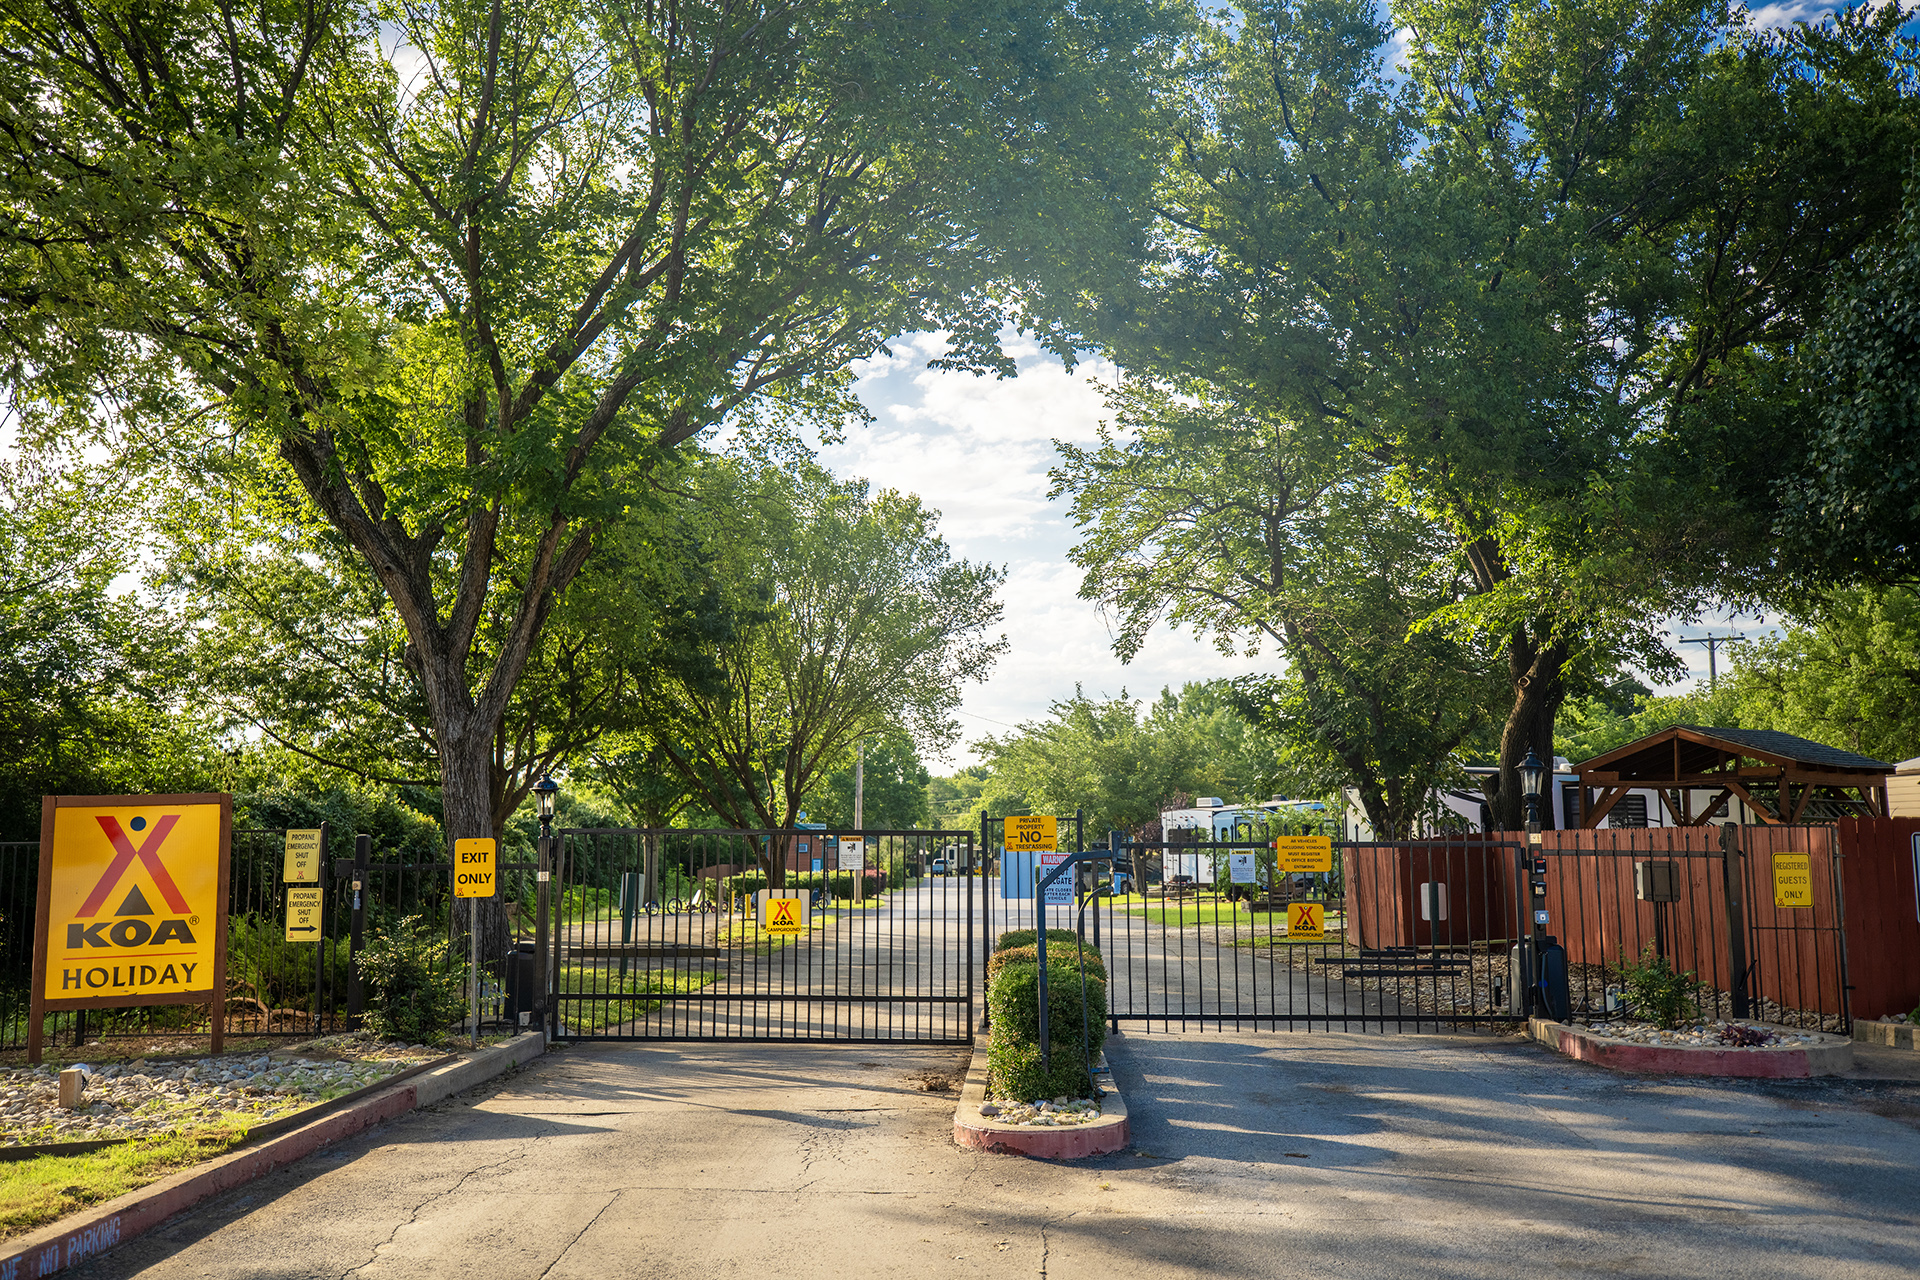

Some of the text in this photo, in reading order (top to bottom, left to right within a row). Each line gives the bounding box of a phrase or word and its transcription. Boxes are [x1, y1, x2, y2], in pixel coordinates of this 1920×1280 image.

[291, 833, 316, 841] PROPANE
[1020, 831, 1042, 843] NO
[287, 842, 319, 850] EMERGENCY
[461, 852, 489, 864] EXIT
[1043, 855, 1069, 864] WARNI
[1775, 862, 1809, 870] REGISTERED
[457, 873, 492, 885] ONLY
[1778, 876, 1808, 885] GUESTS
[1784, 890, 1804, 899] ONLY
[62, 962, 199, 990] HOLIDAY
[39, 1244, 59, 1277] NO
[67, 1216, 120, 1267] PARKING
